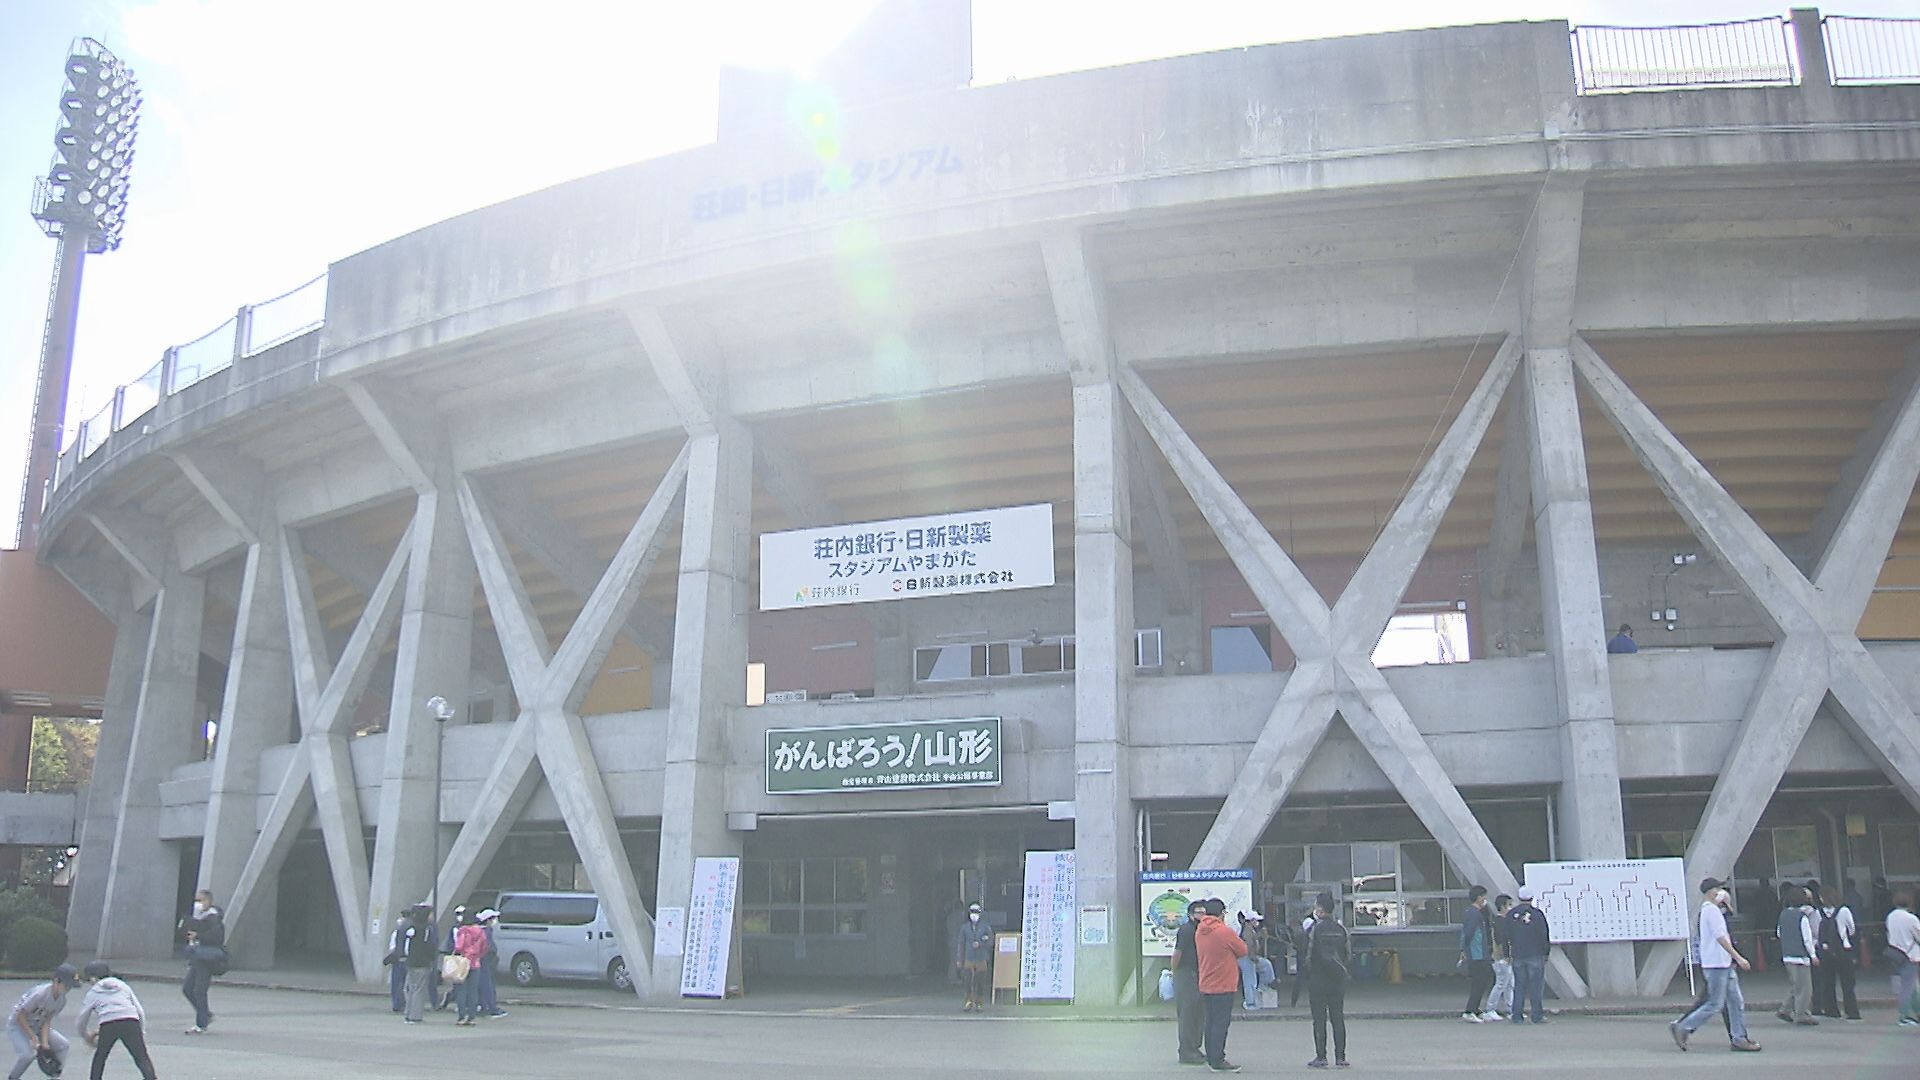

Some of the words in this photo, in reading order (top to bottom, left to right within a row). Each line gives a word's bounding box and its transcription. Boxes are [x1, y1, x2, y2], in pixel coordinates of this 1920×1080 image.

[813, 521, 992, 560] 荘内銀行・日新製薬
[828, 549, 977, 578] スタジアムやまがた
[905, 570, 1014, 591] 日新製薬株式会社
